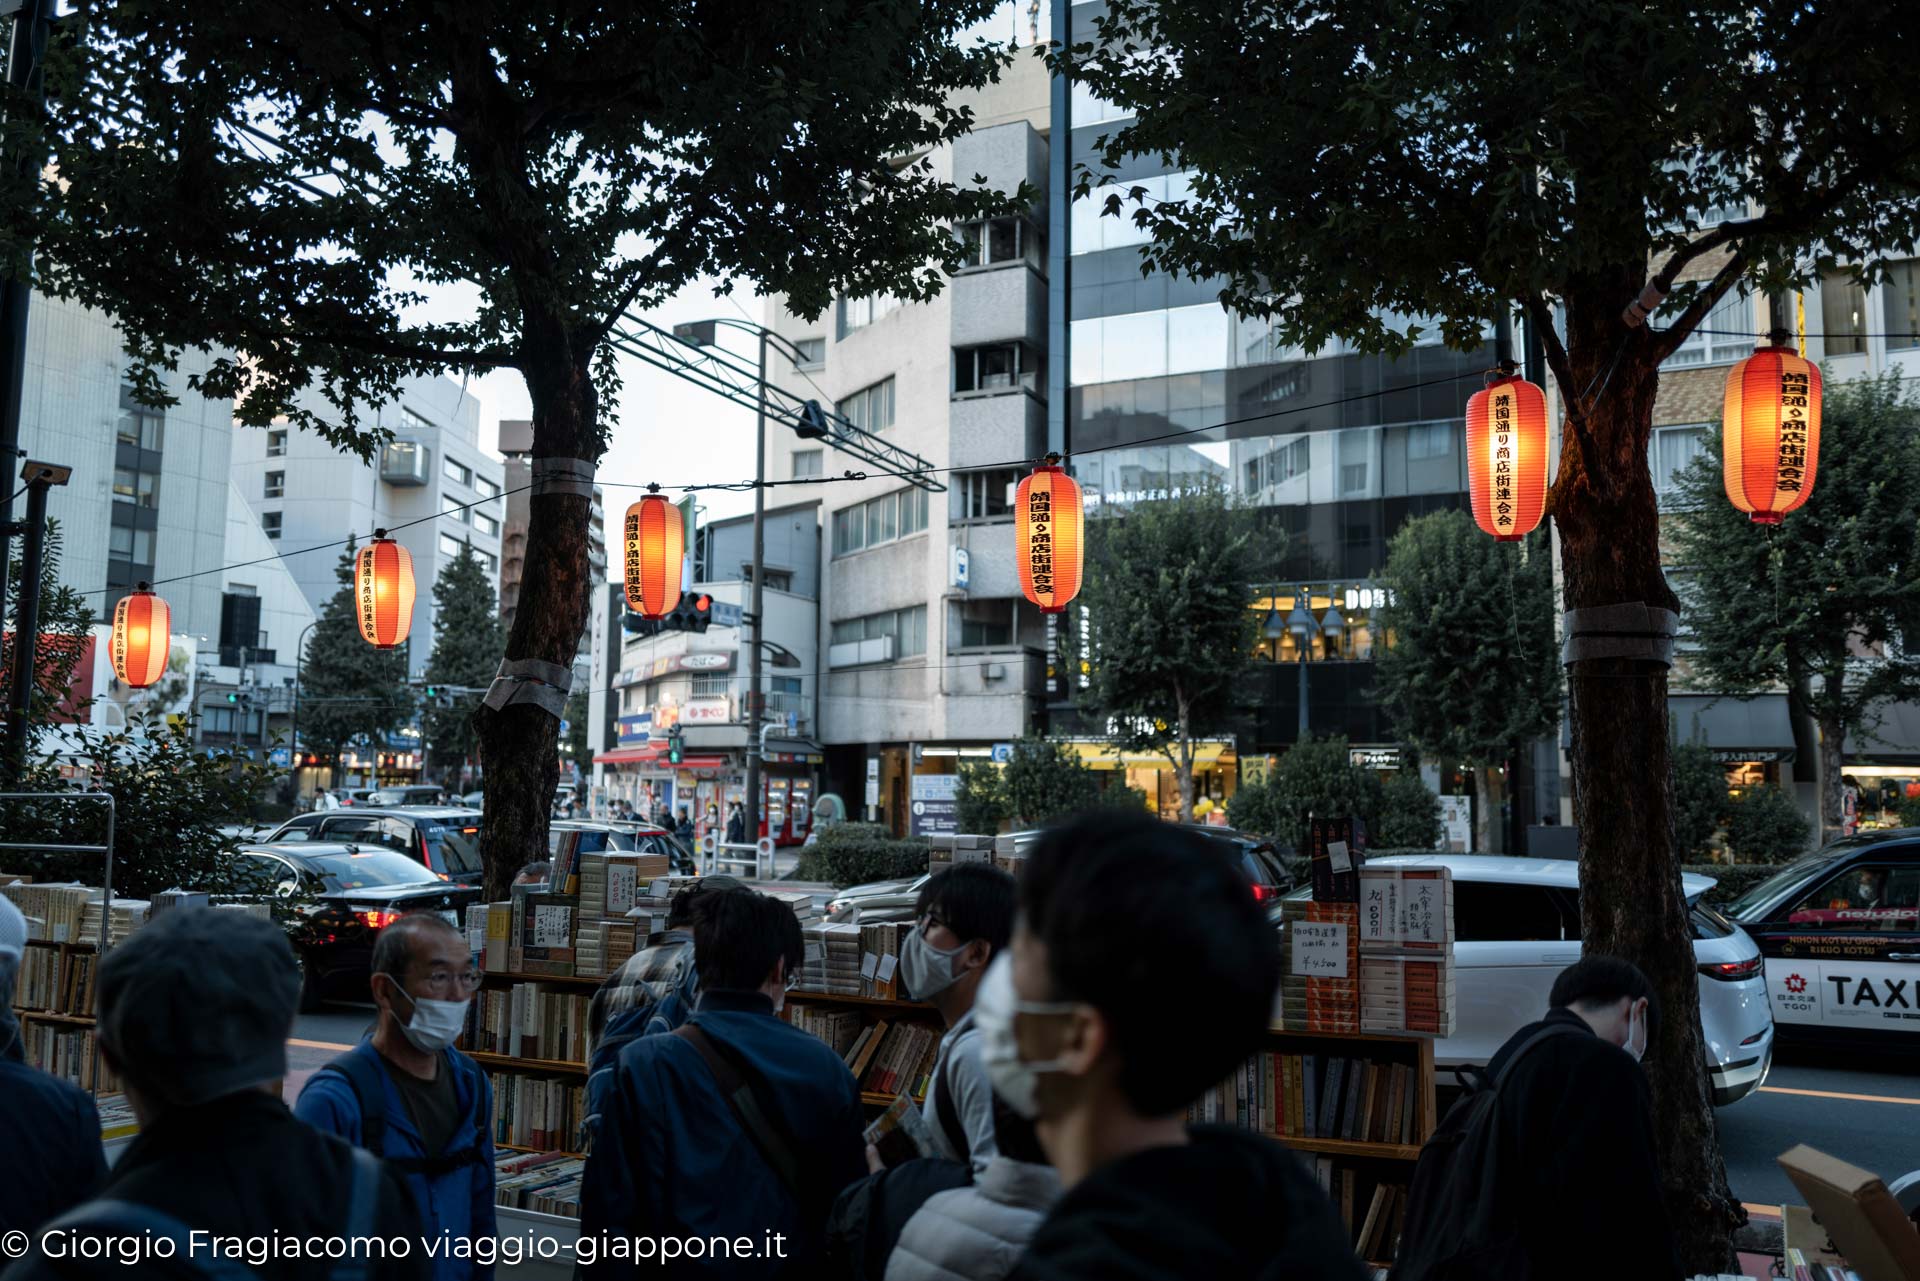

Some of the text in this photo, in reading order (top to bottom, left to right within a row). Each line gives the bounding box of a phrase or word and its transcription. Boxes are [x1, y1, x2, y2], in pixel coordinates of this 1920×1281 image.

[1494, 394, 1513, 526] 靖国通り商店街連合会
[1777, 371, 1809, 493] 靖国通り商店街連合会
[626, 514, 643, 603] 靖国通り商店街連合会
[1030, 491, 1053, 594] 靖国通り商店街連合会
[362, 550, 375, 639] 靖国通り商店街連合会
[1418, 884, 1433, 940] 太宰治全集
[1790, 936, 1888, 946] NIHON KOTSU GROUP
[1809, 945, 1876, 955] RIKUO KOTSU
[1777, 994, 1816, 1003] 日本交通
[1783, 1003, 1811, 1011] でGO!
